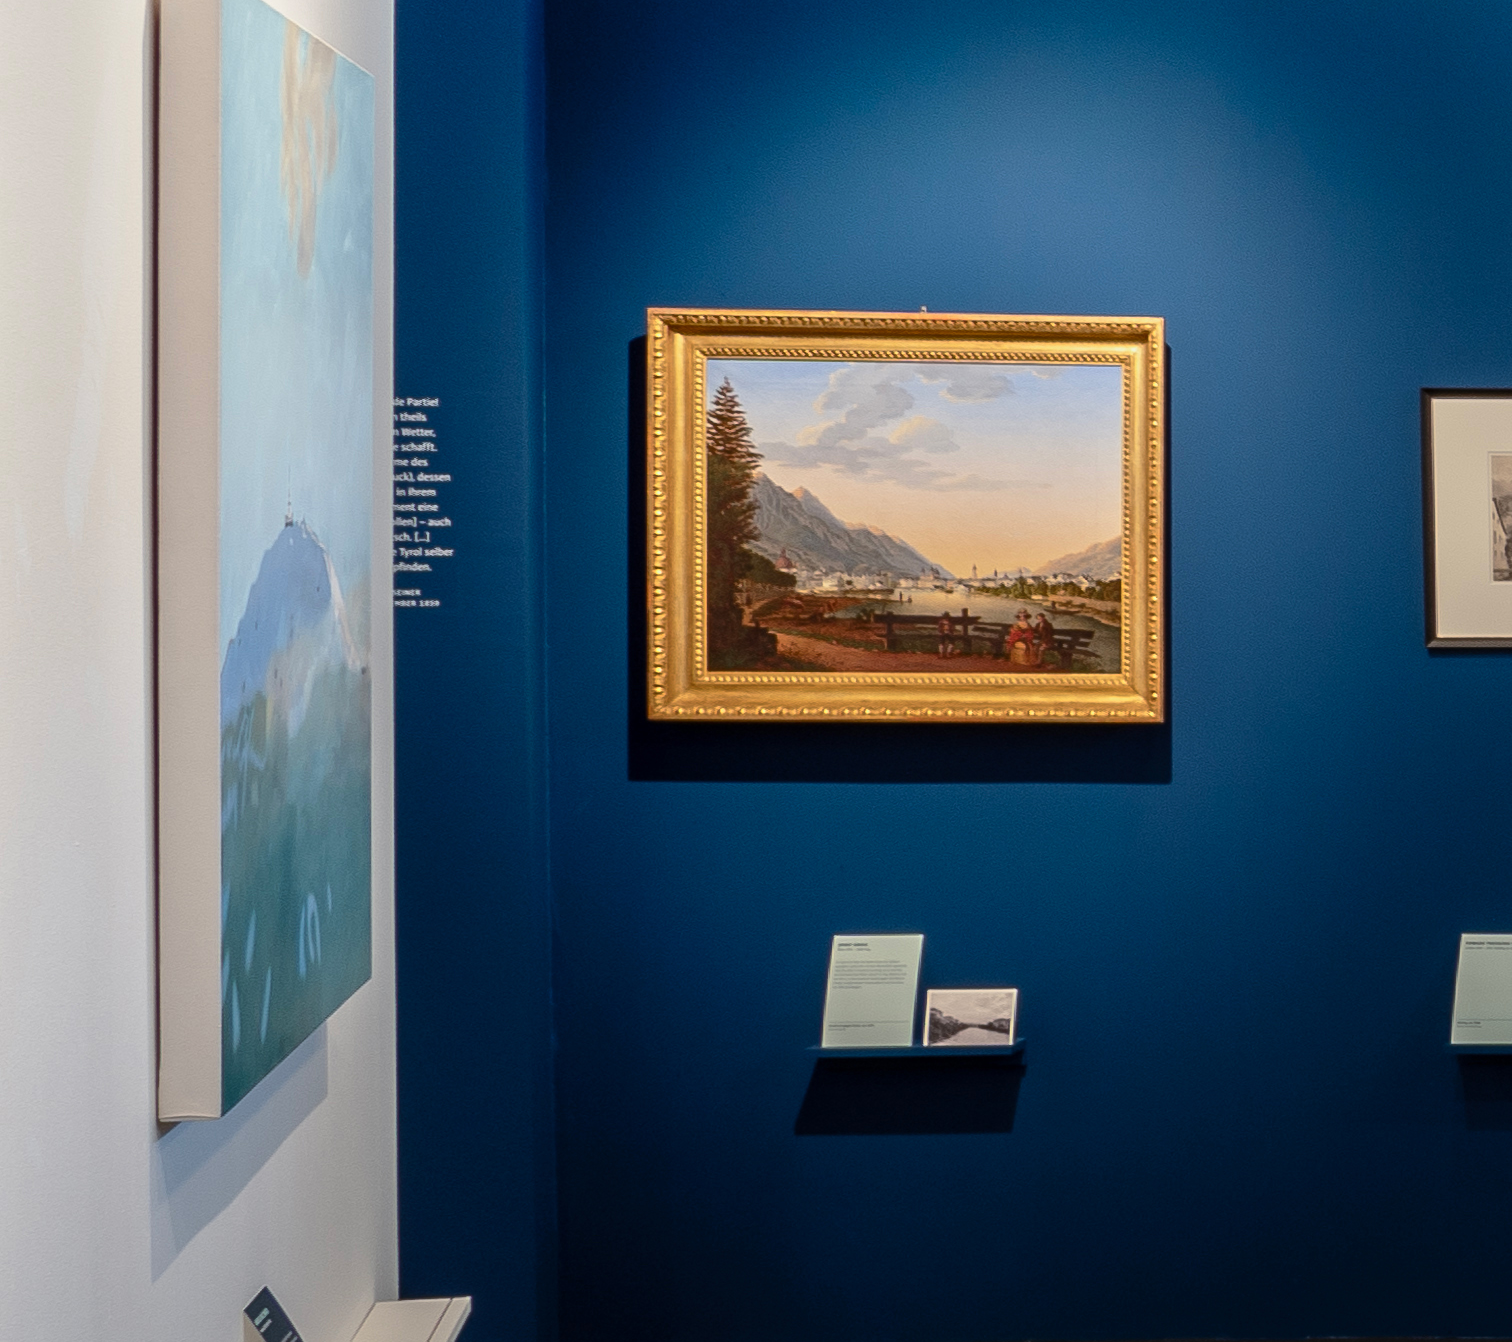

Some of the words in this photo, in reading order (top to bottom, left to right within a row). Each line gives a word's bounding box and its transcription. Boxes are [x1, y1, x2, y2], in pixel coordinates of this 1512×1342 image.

[410, 457, 429, 467] des
[416, 472, 452, 482] dessen
[417, 503, 439, 512] eine
[427, 517, 452, 527] auch
